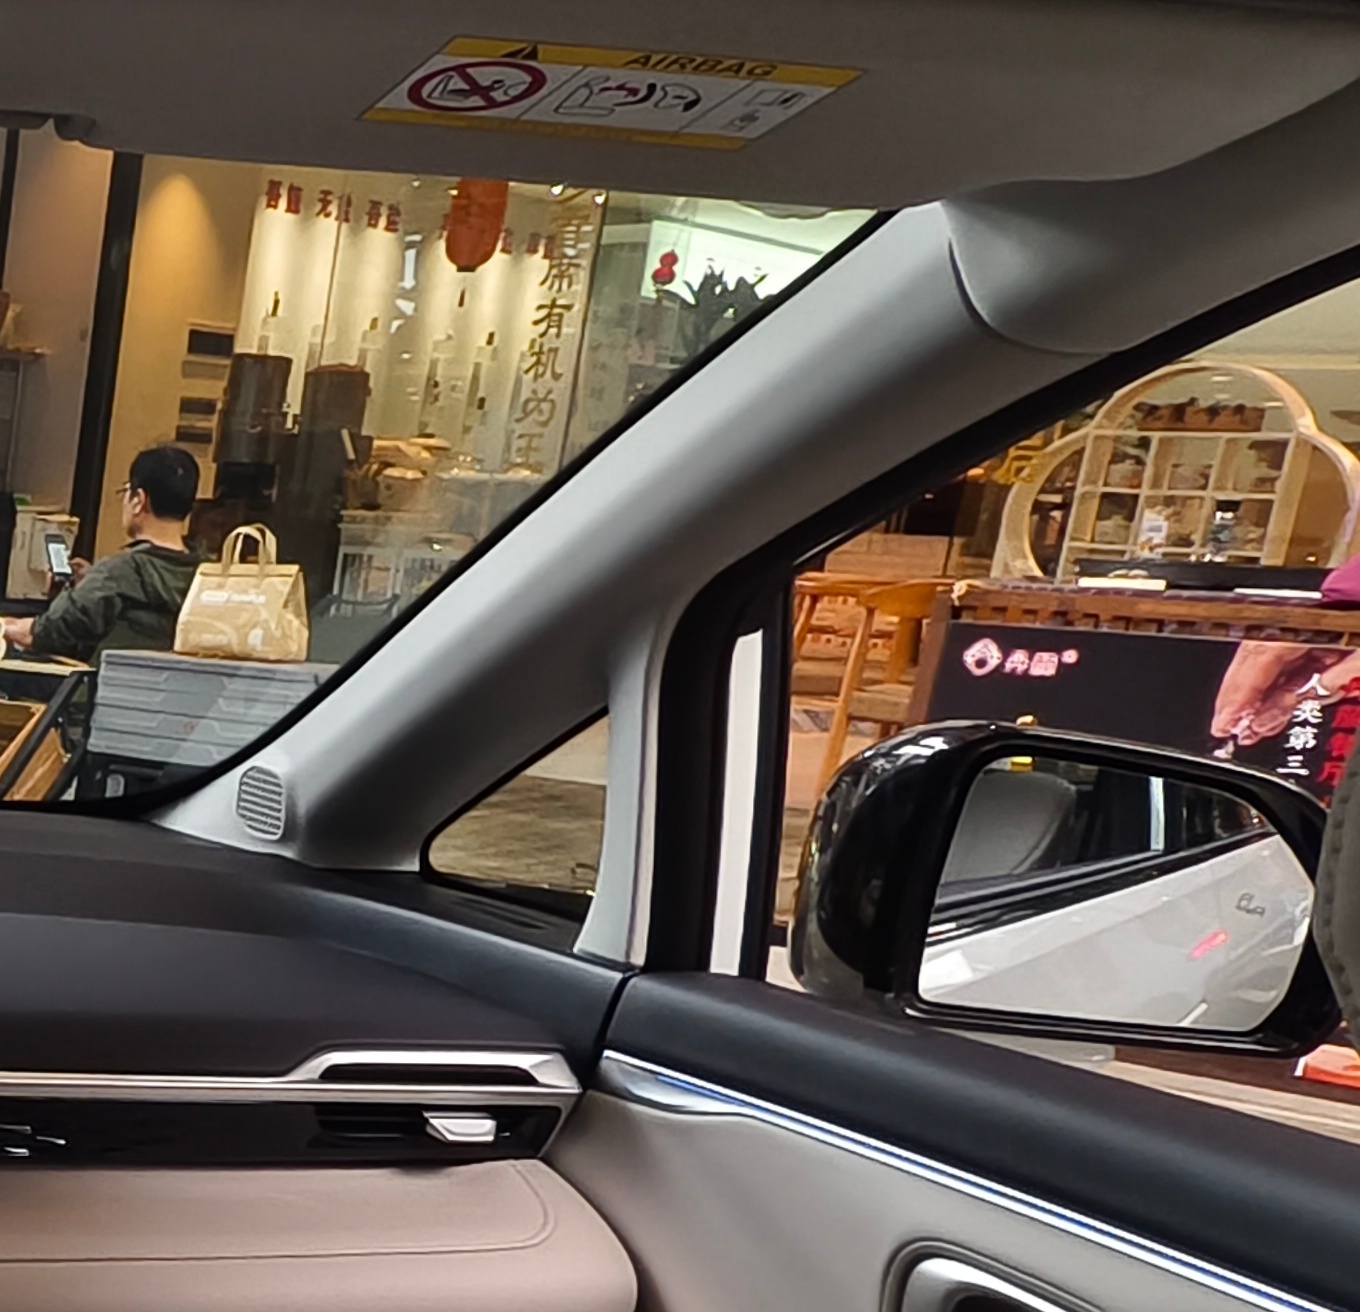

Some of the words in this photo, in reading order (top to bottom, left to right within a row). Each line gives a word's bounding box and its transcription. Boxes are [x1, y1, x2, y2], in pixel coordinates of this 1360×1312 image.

[624, 54, 778, 77] AIRBAG
[1276, 673, 1331, 786] 人类第三
